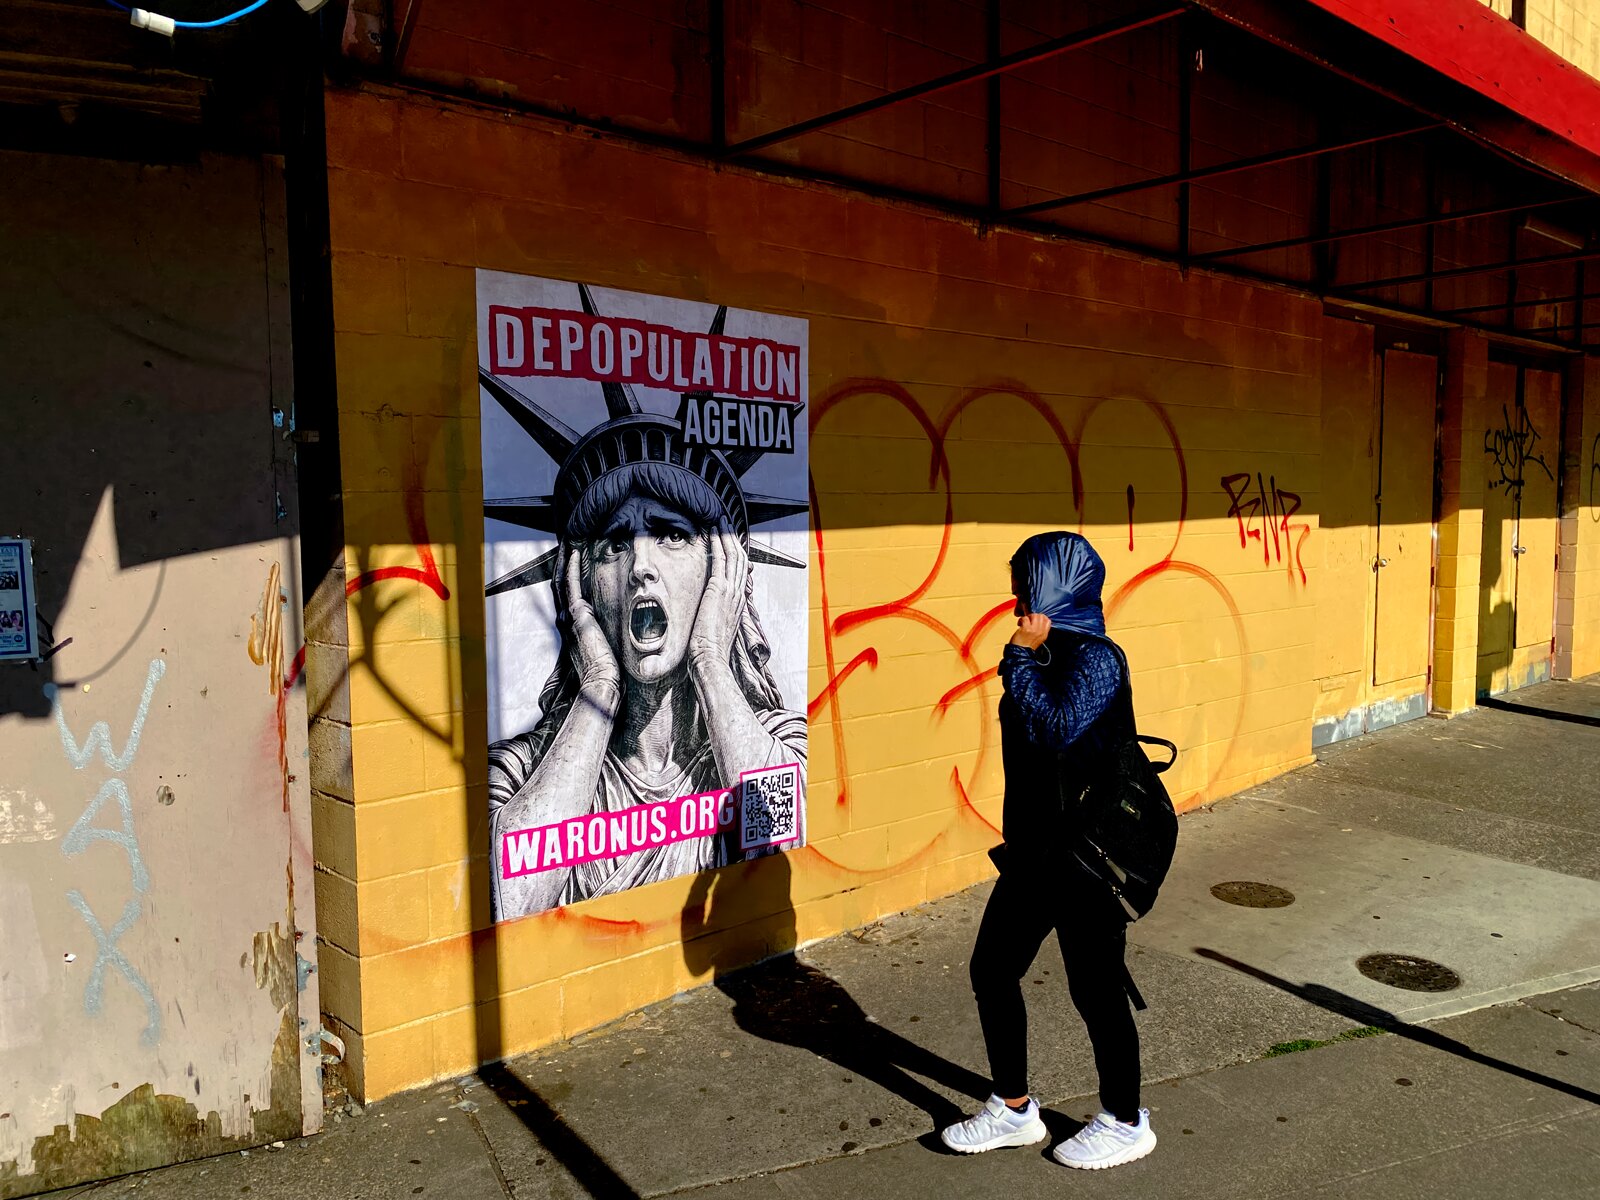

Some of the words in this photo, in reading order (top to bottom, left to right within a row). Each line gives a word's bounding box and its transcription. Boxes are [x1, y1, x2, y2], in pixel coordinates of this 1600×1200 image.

[495, 313, 797, 397] DEPOPULATION
[684, 398, 792, 449] AGENDA
[43, 658, 166, 1048] WAX
[506, 795, 735, 874] WARONUS.ORG
